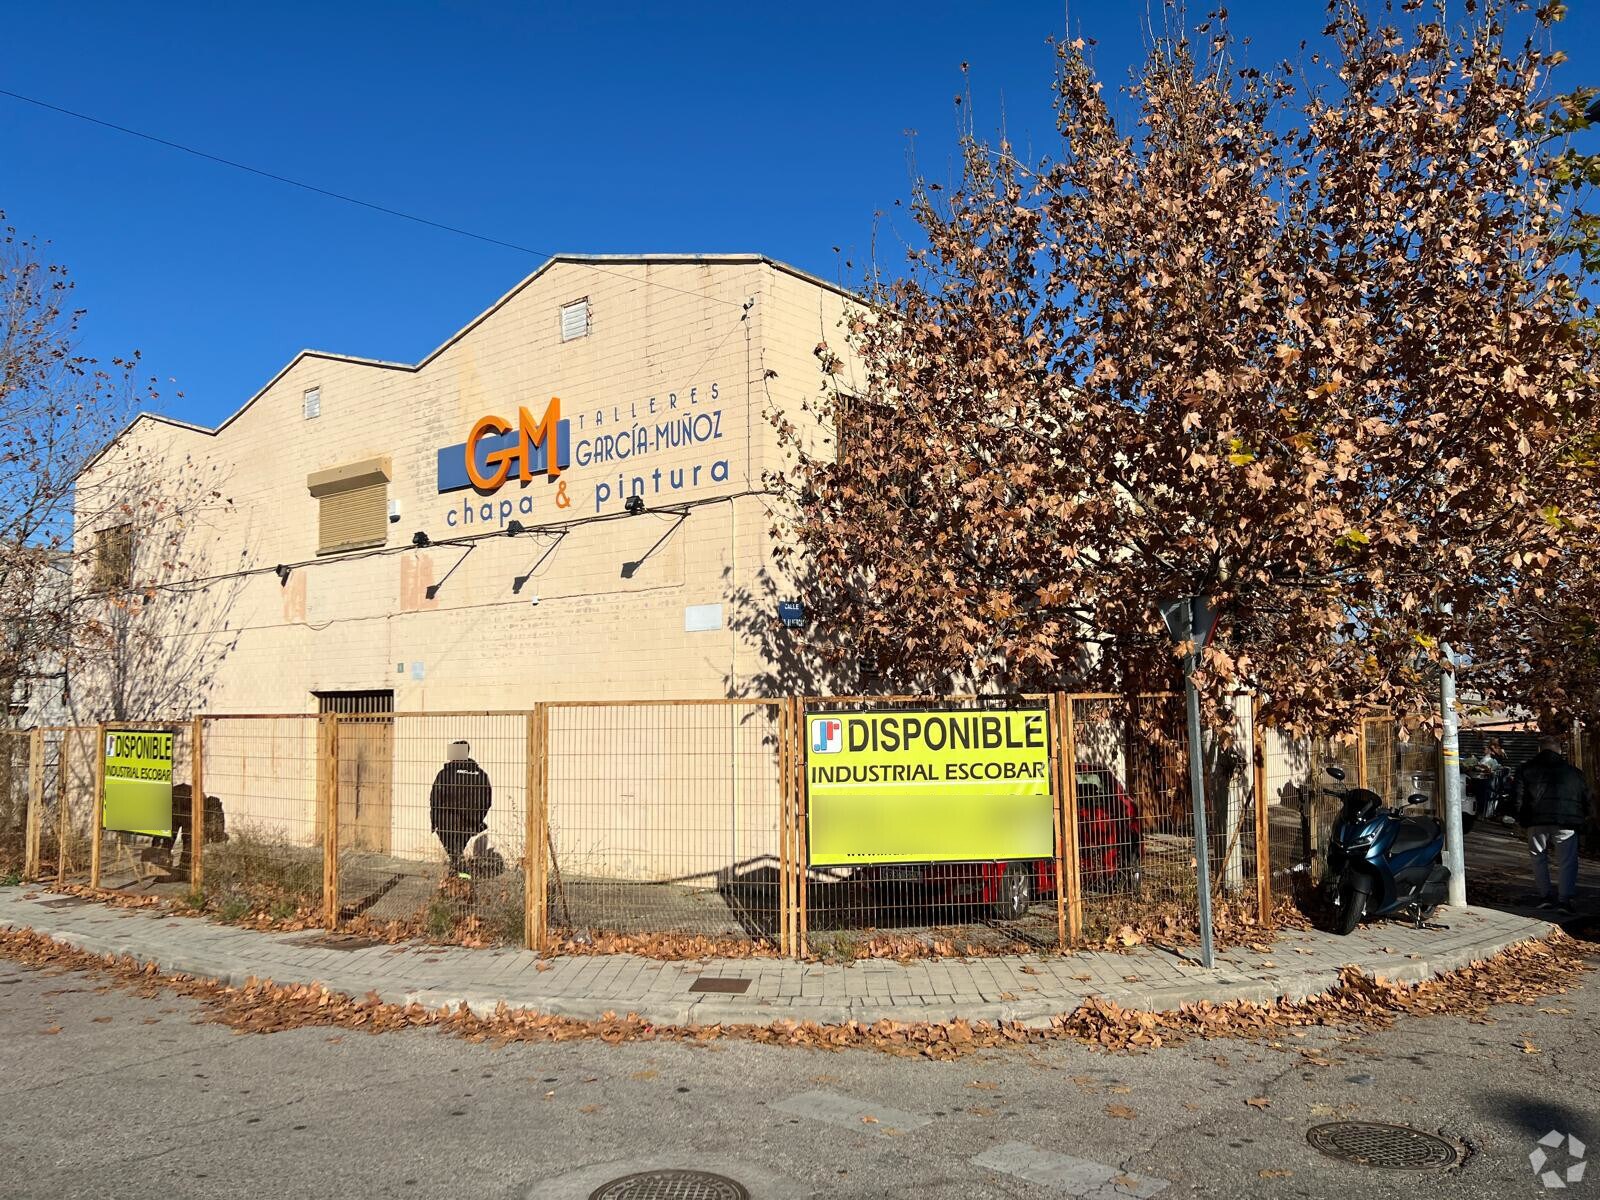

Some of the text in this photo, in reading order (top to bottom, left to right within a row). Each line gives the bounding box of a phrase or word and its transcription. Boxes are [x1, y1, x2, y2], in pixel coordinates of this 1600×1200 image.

[579, 382, 719, 429] TALLERES
[465, 396, 560, 491] GM
[576, 410, 723, 467] GARCÍA-MUÑOZ
[447, 459, 729, 528] chapa & pintura
[115, 735, 171, 760] DISPONIBLE
[849, 715, 1044, 753] DISPONIBLE
[106, 765, 171, 781] INDUSTRIAL ESCOBAR
[811, 761, 1045, 784] INDUSTRIAL ESCOBAR
